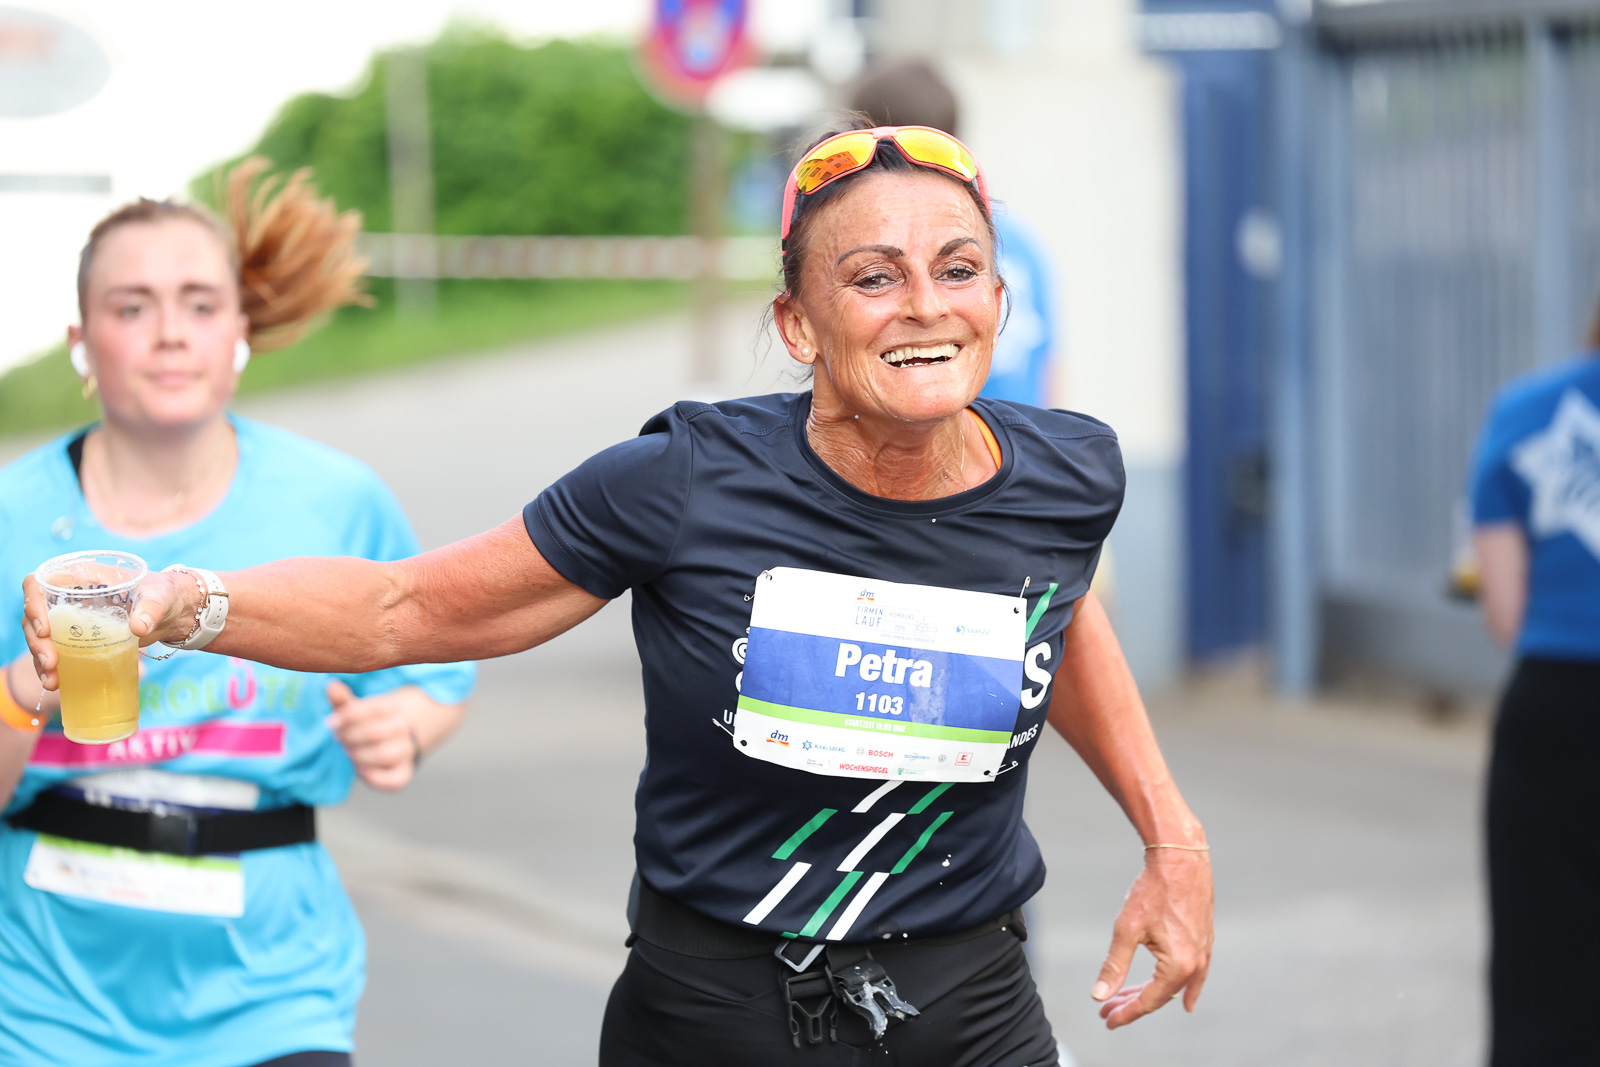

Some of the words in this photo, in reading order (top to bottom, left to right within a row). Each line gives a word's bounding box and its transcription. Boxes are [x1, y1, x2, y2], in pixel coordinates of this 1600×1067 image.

[860, 588, 875, 598] dm
[857, 605, 884, 616] FIRMEN
[855, 615, 882, 628] LAUF
[834, 642, 934, 688] Petra
[855, 692, 904, 715] 1103
[844, 718, 876, 729] STARTZEIT
[892, 723, 907, 733] UHR
[770, 729, 789, 743] dm
[814, 743, 846, 753] KARLSBERG
[868, 749, 894, 758] BOSCH
[839, 762, 889, 775] WOCHENSPIEGEL
